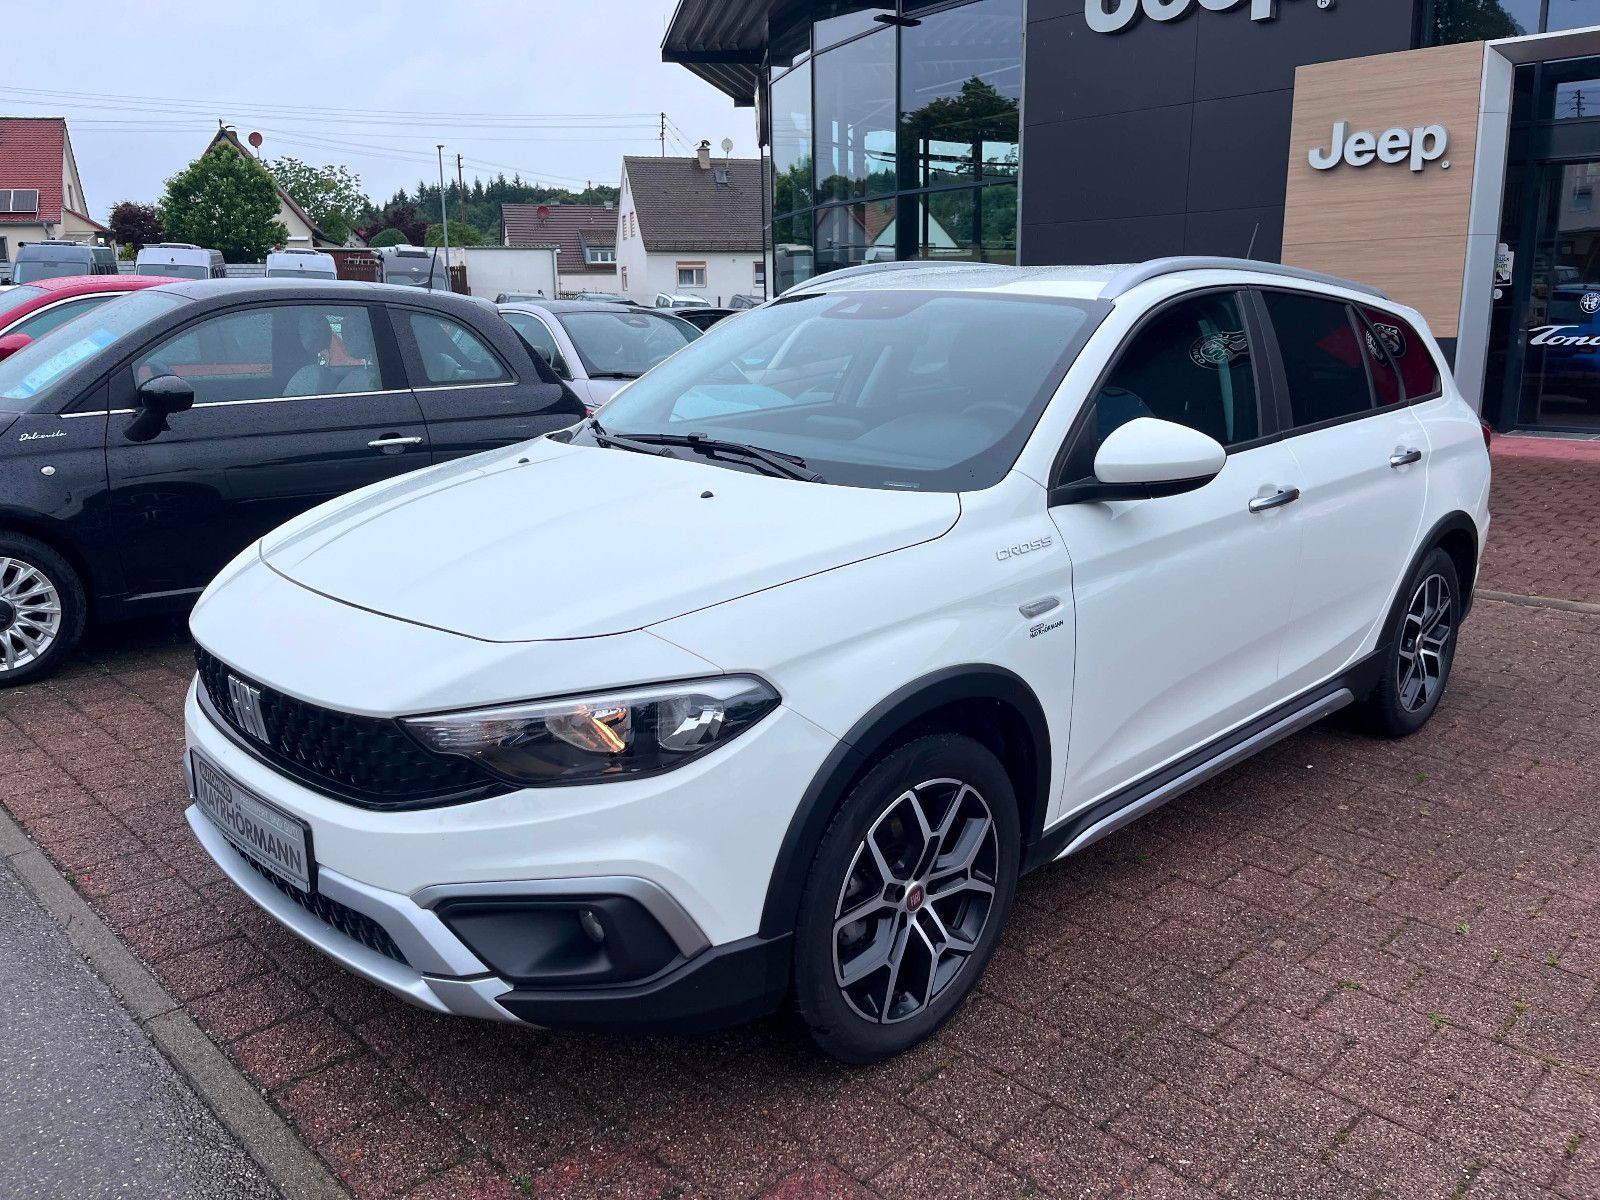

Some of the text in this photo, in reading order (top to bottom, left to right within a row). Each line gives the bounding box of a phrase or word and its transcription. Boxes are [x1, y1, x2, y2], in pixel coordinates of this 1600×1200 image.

[1308, 120, 1448, 172] Jeep
[996, 536, 1052, 561] CROSS
[227, 674, 270, 744] FIAT
[200, 779, 302, 874] MAYRHÖRMANN
